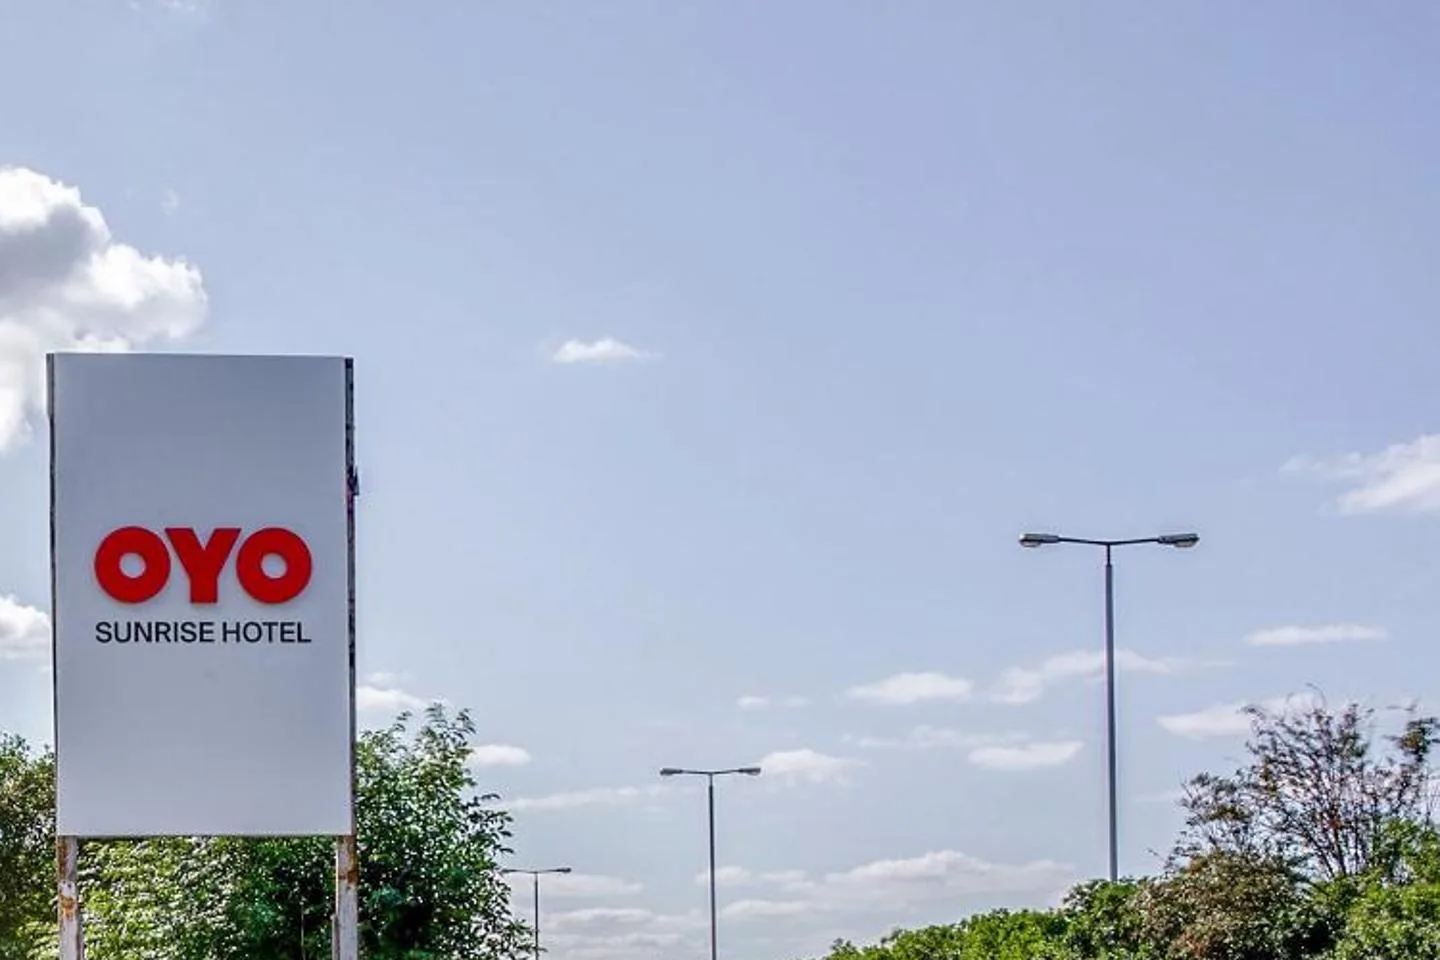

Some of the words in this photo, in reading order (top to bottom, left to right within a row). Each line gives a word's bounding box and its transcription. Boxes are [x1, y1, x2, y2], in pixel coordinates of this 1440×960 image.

[94, 526, 313, 604] OYO
[95, 621, 216, 644] SUNRISE
[222, 621, 312, 644] HOTEL
